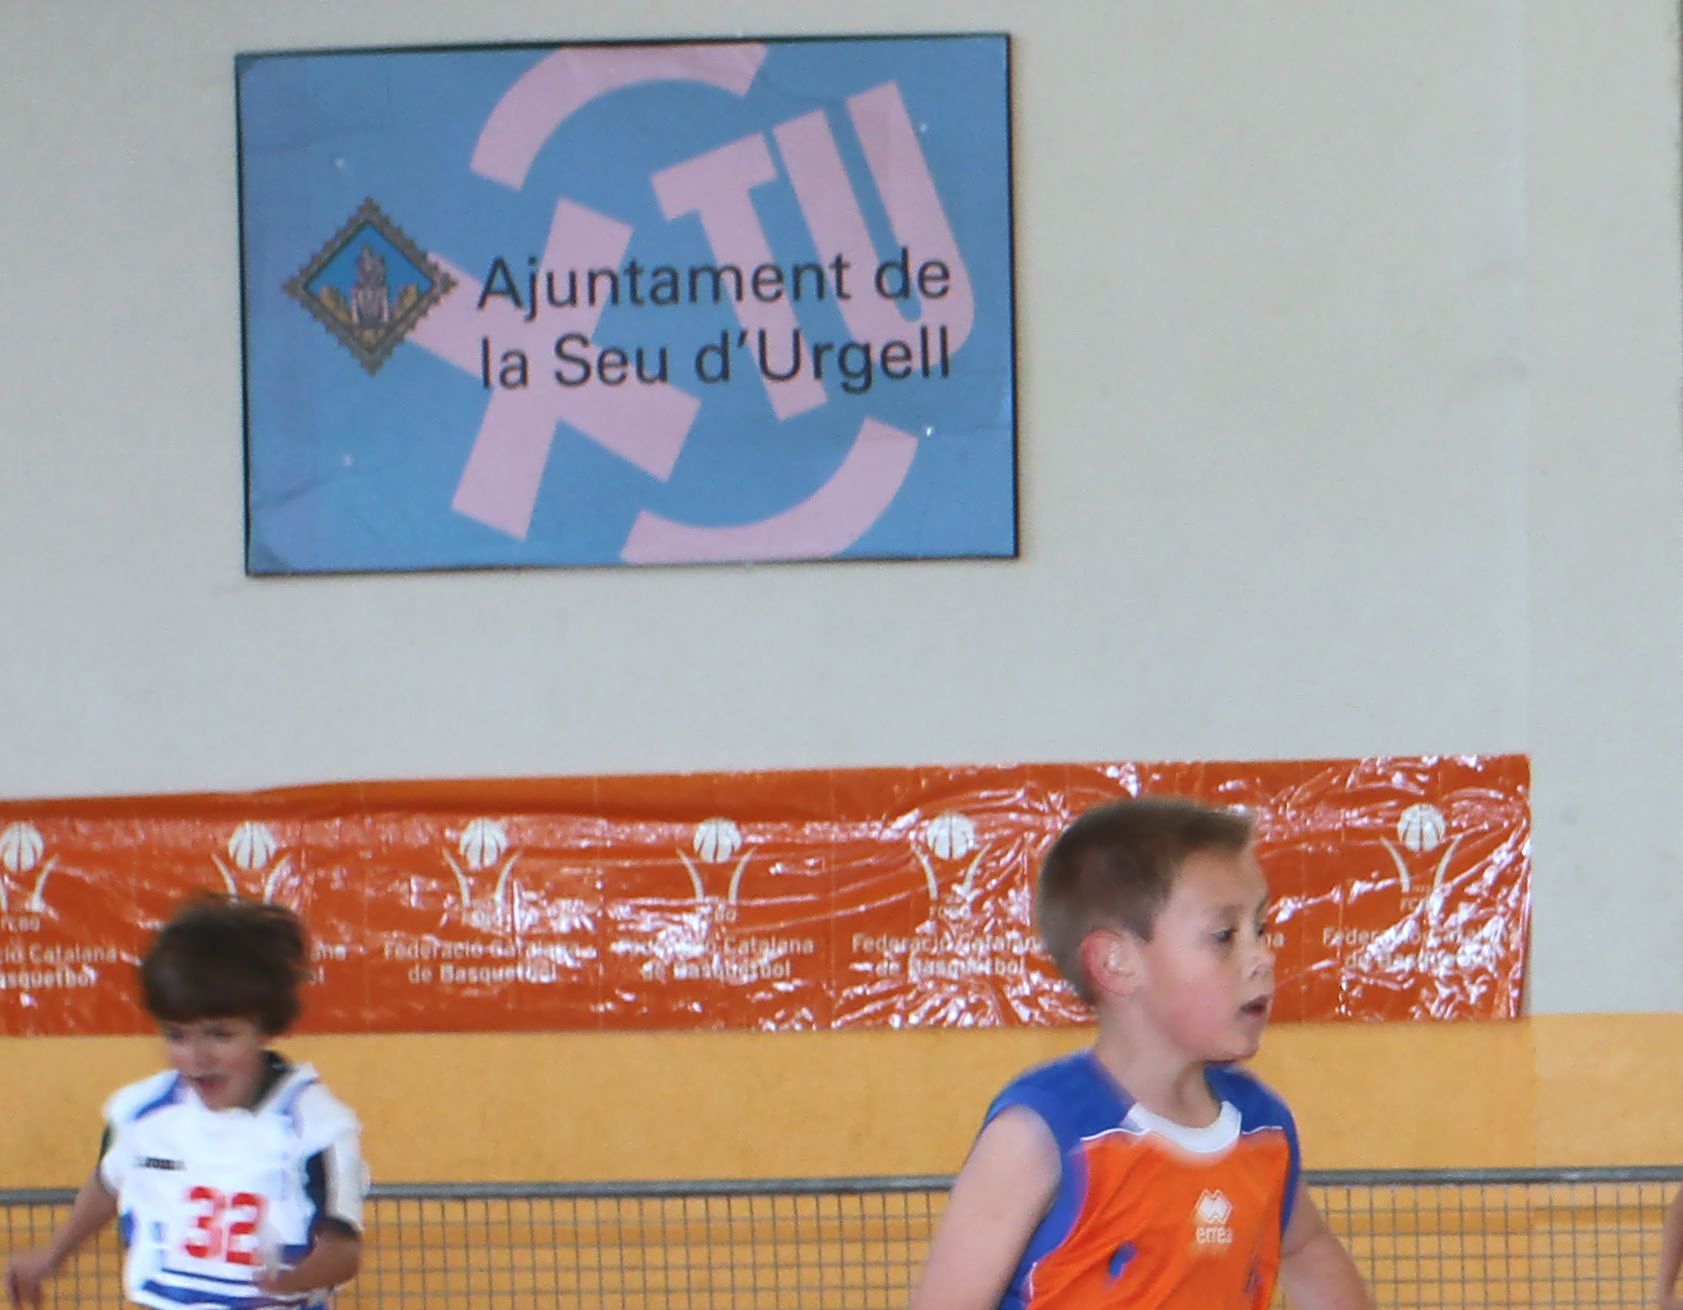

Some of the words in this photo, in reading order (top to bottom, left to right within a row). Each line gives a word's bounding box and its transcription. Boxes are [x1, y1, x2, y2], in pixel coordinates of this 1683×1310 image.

[477, 253, 850, 326] Ajuntament
[874, 246, 952, 300] de
[480, 334, 530, 389] la
[553, 333, 670, 387] Seu
[695, 326, 952, 394] d'Urgell
[183, 1186, 264, 1266] 32
